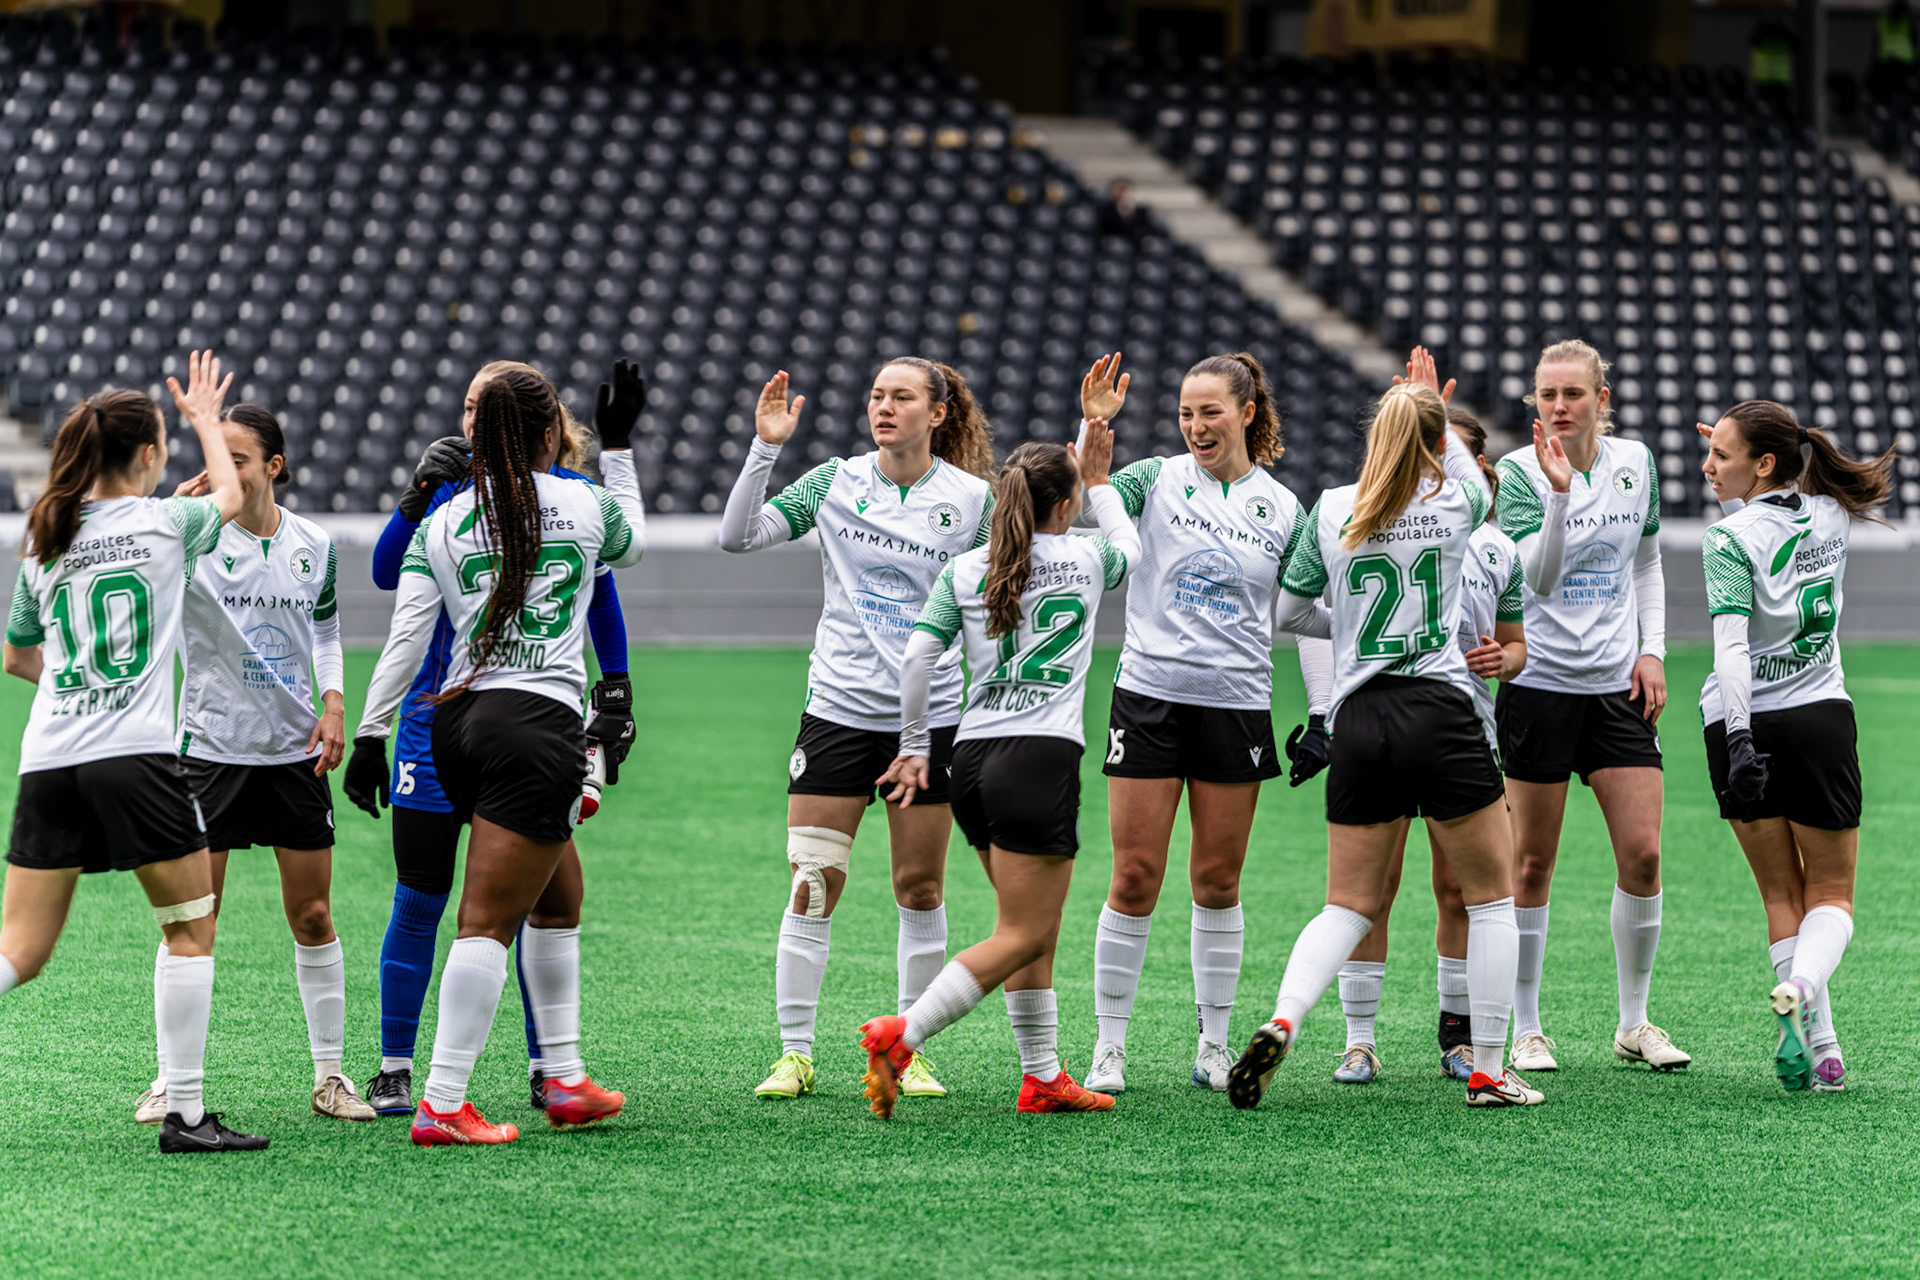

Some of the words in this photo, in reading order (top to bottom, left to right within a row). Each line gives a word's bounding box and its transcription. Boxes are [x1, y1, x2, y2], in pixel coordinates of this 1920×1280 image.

[1367, 526, 1452, 545] Populaires
[63, 547, 152, 573] Populaires
[1795, 537, 1844, 564] Retraites
[1032, 560, 1079, 577] raites
[1024, 572, 1092, 593] pulaires
[1177, 577, 1201, 593] GRAND
[1562, 577, 1588, 587] GRAND
[1570, 588, 1596, 599] CENTRE
[1207, 597, 1240, 615] THERMAL
[1345, 547, 1451, 662] 21
[50, 568, 154, 695] 10
[979, 593, 1088, 689] 12
[469, 641, 546, 670] MSSOMO
[605, 688, 625, 699] Bjørn
[983, 686, 1005, 710] DA
[1006, 686, 1051, 712] COST
